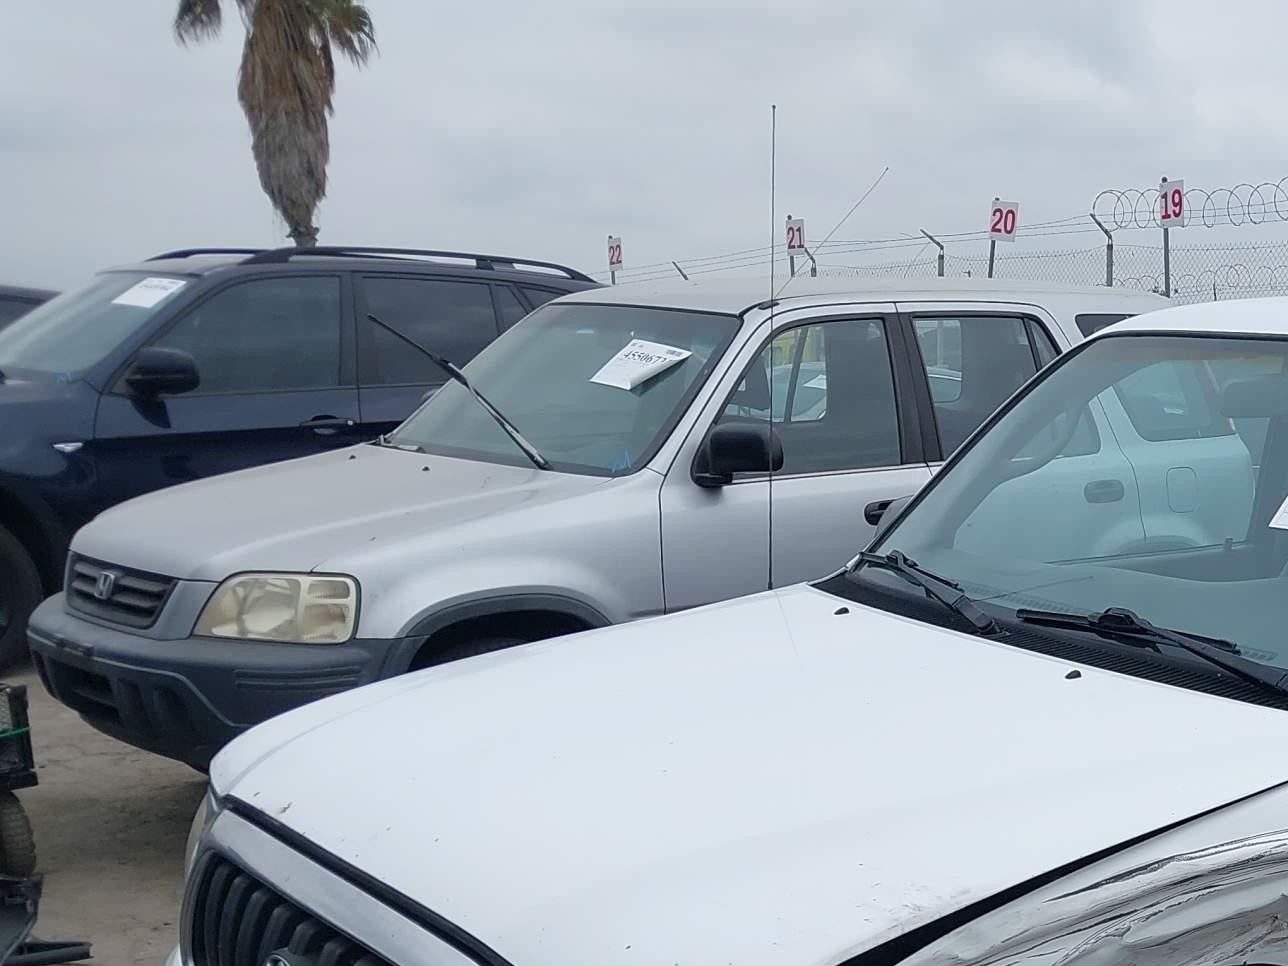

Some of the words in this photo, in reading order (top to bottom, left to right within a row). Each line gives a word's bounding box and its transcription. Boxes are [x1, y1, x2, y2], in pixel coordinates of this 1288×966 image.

[1161, 188, 1183, 219] 19
[991, 207, 1016, 235] 20
[786, 226, 805, 249] 21
[608, 244, 623, 266] 22
